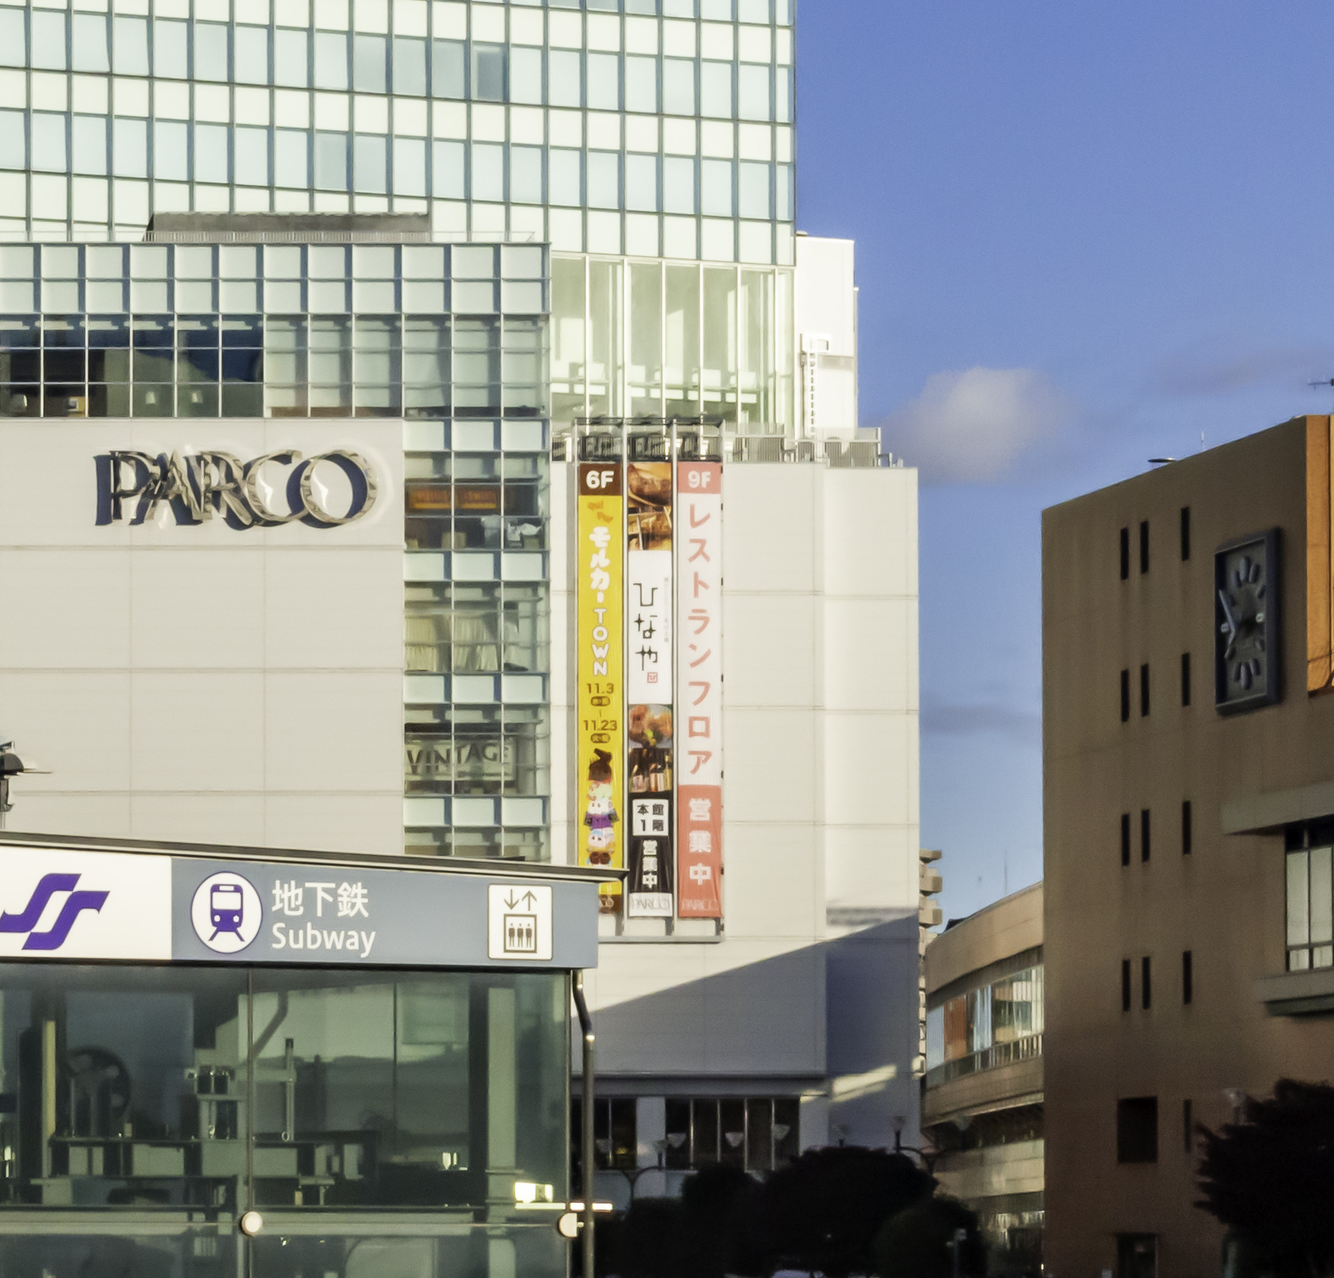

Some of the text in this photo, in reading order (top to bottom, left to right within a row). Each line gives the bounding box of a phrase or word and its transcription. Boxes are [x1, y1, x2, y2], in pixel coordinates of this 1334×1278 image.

[92, 449, 378, 531] PARCO
[586, 470, 614, 489] 6F
[687, 470, 711, 489] 9F
[632, 582, 659, 672] ひなや
[687, 503, 712, 775] レストランフロア
[586, 682, 615, 694] 11.3
[583, 719, 618, 731] 11.23
[636, 803, 665, 816] 本館
[688, 797, 712, 886] 営業中
[642, 840, 658, 890] 営業中
[271, 879, 369, 918] 地下鉄
[632, 898, 671, 911] PARCO
[271, 921, 376, 958] Subway
